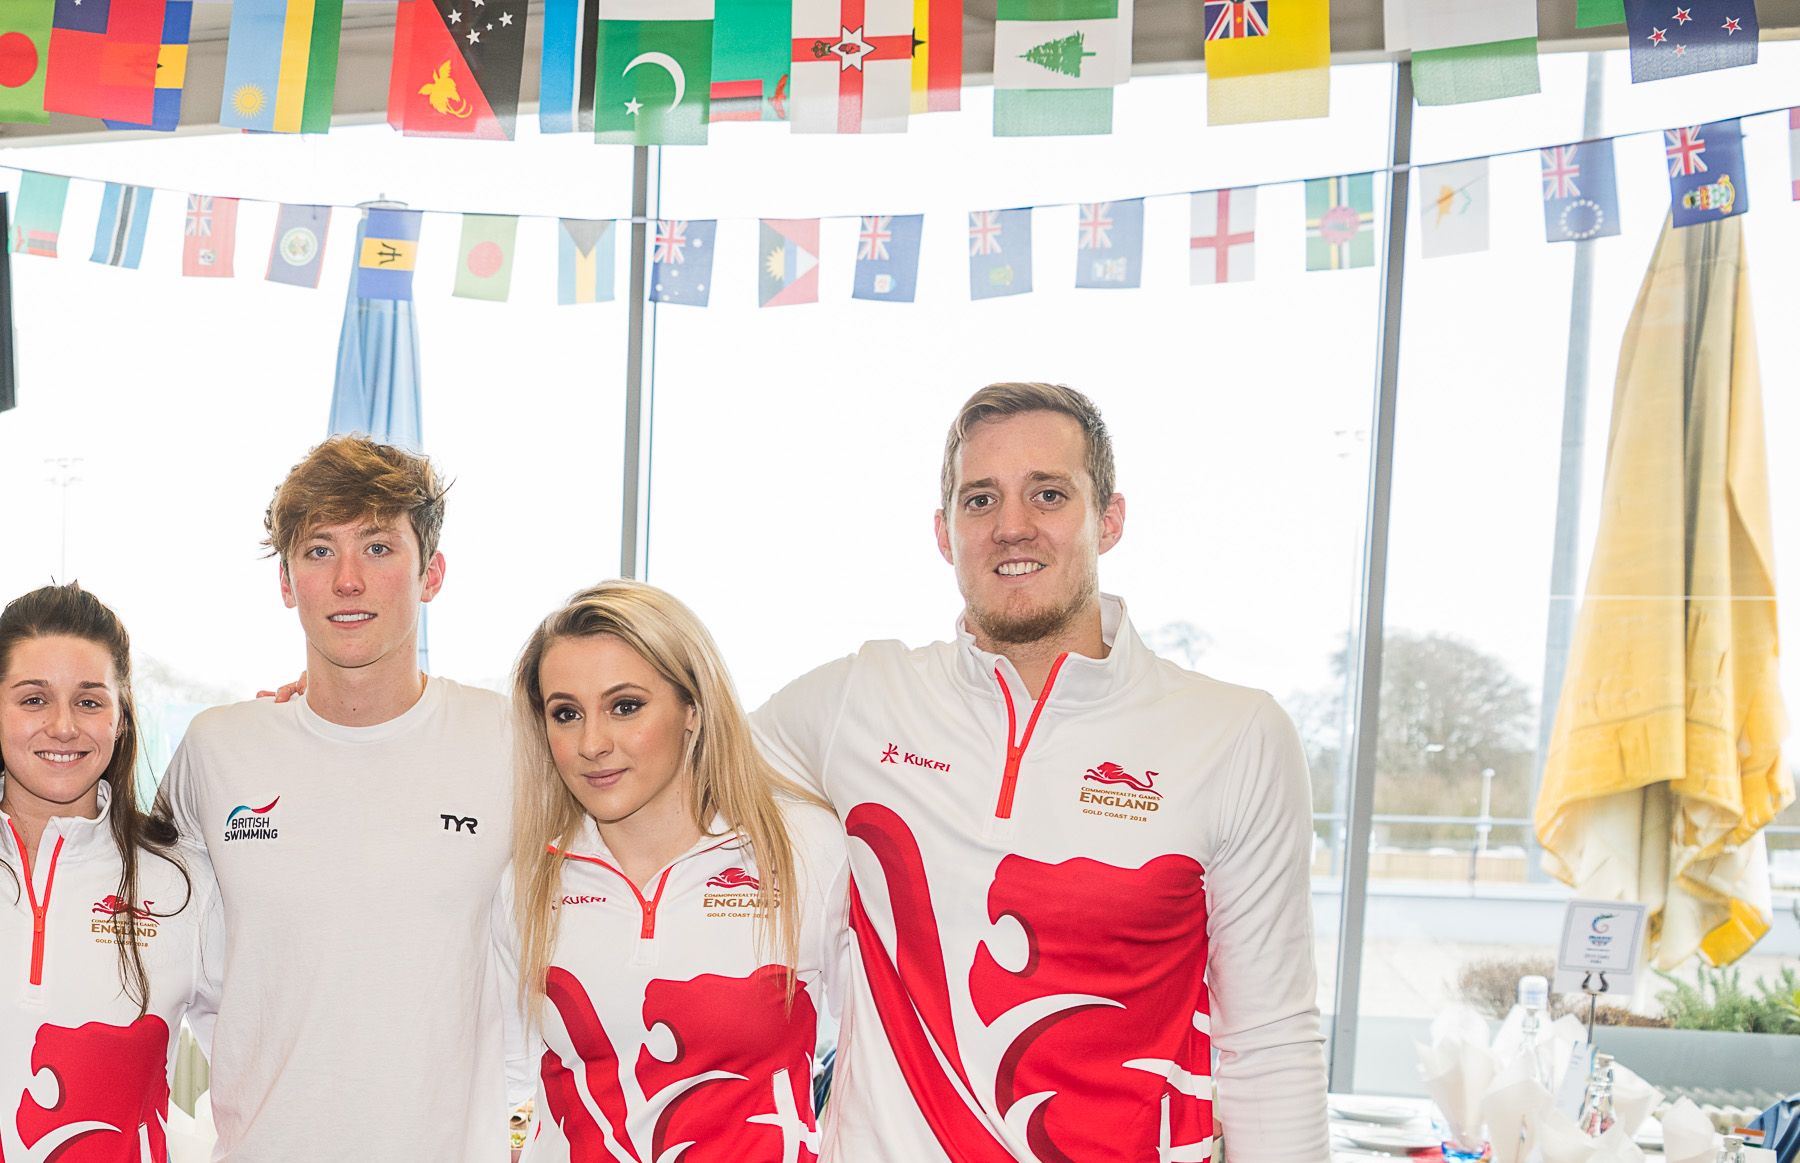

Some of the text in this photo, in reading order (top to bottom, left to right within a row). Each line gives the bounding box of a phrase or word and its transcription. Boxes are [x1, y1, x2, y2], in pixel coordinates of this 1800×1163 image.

[903, 752, 951, 773] KUKRI
[1081, 786, 1161, 801] COMMONWEALTH GAMES
[1079, 791, 1160, 812] ENGLAND
[231, 816, 270, 829] BRITISH
[1082, 808, 1148, 823] GOLD COAST 2018
[440, 813, 478, 835] TYR
[224, 828, 278, 842] SWIMMING
[561, 895, 607, 905] KUKRI
